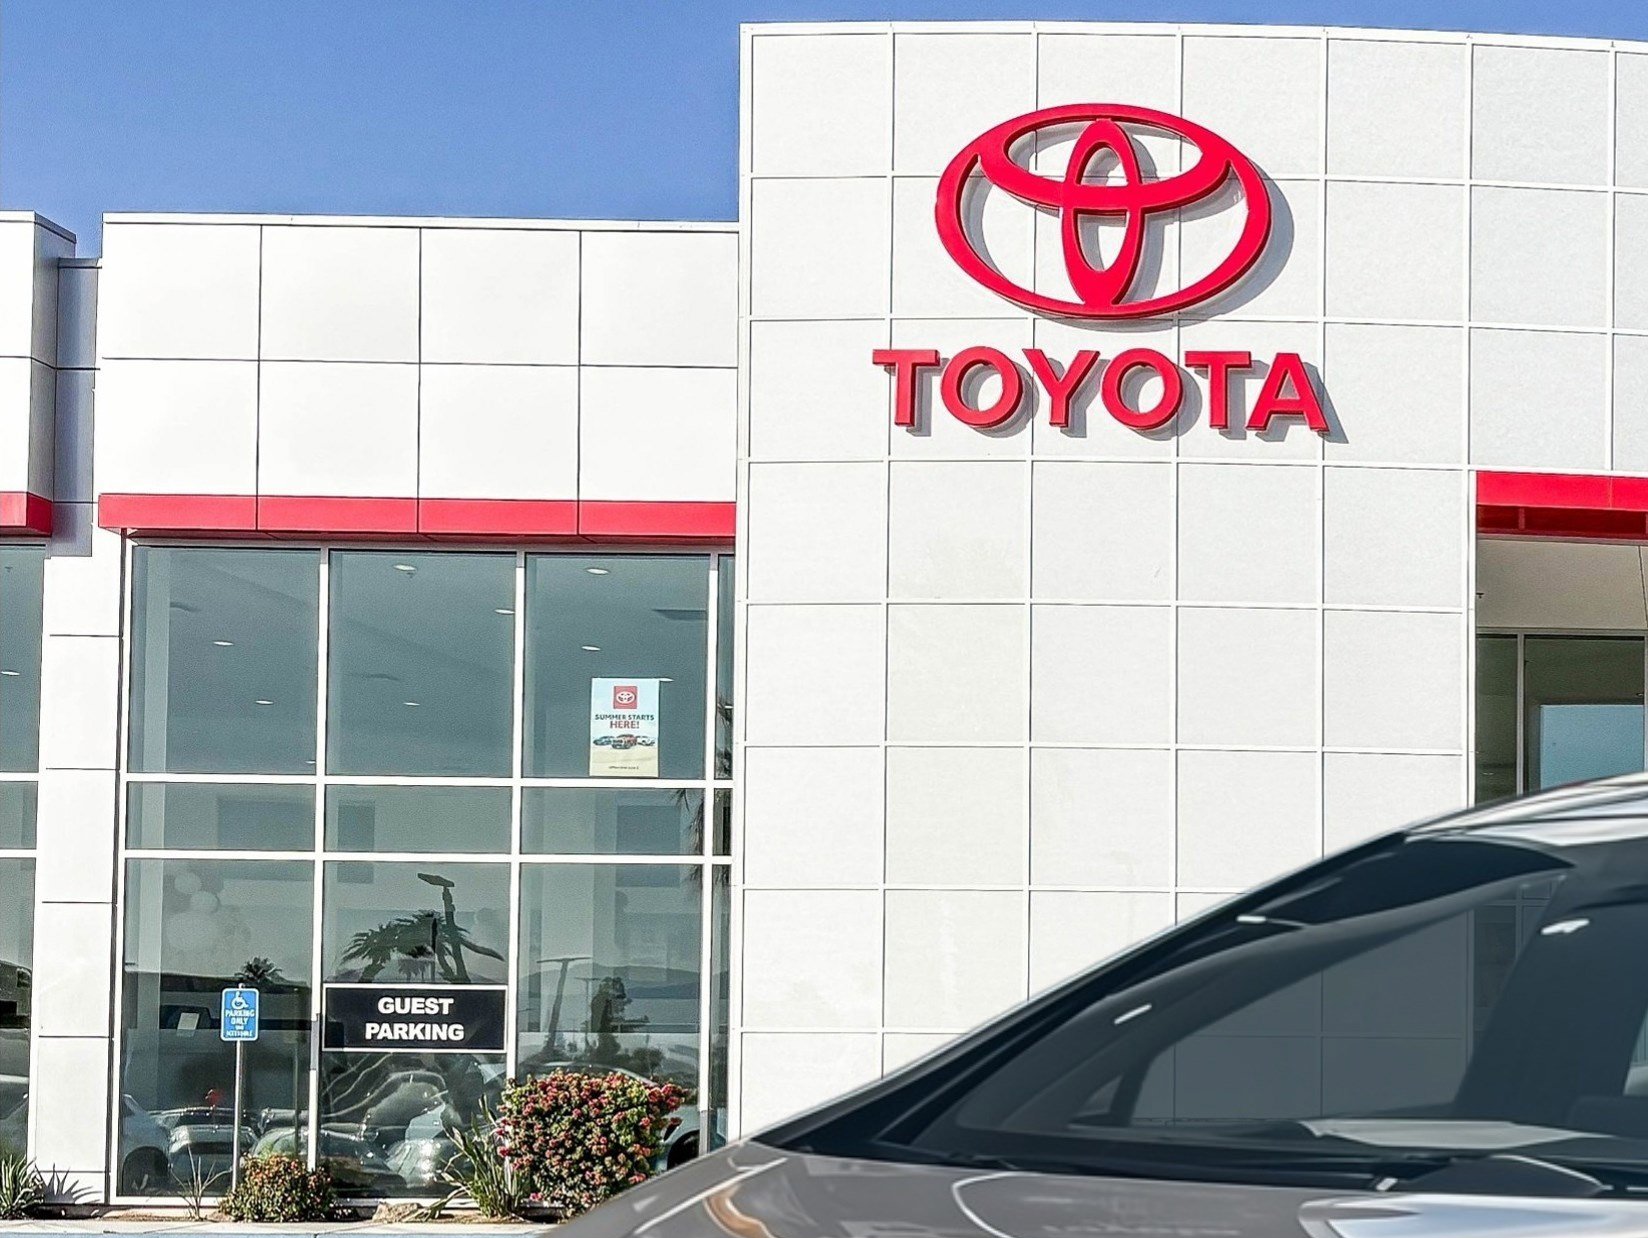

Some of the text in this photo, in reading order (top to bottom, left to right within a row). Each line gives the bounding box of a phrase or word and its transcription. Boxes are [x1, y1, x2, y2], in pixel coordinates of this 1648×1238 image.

[872, 345, 1329, 433] TOYOTA
[609, 720, 640, 729] HERE!
[377, 997, 455, 1015] GUEST
[364, 1023, 465, 1041] PARKING
